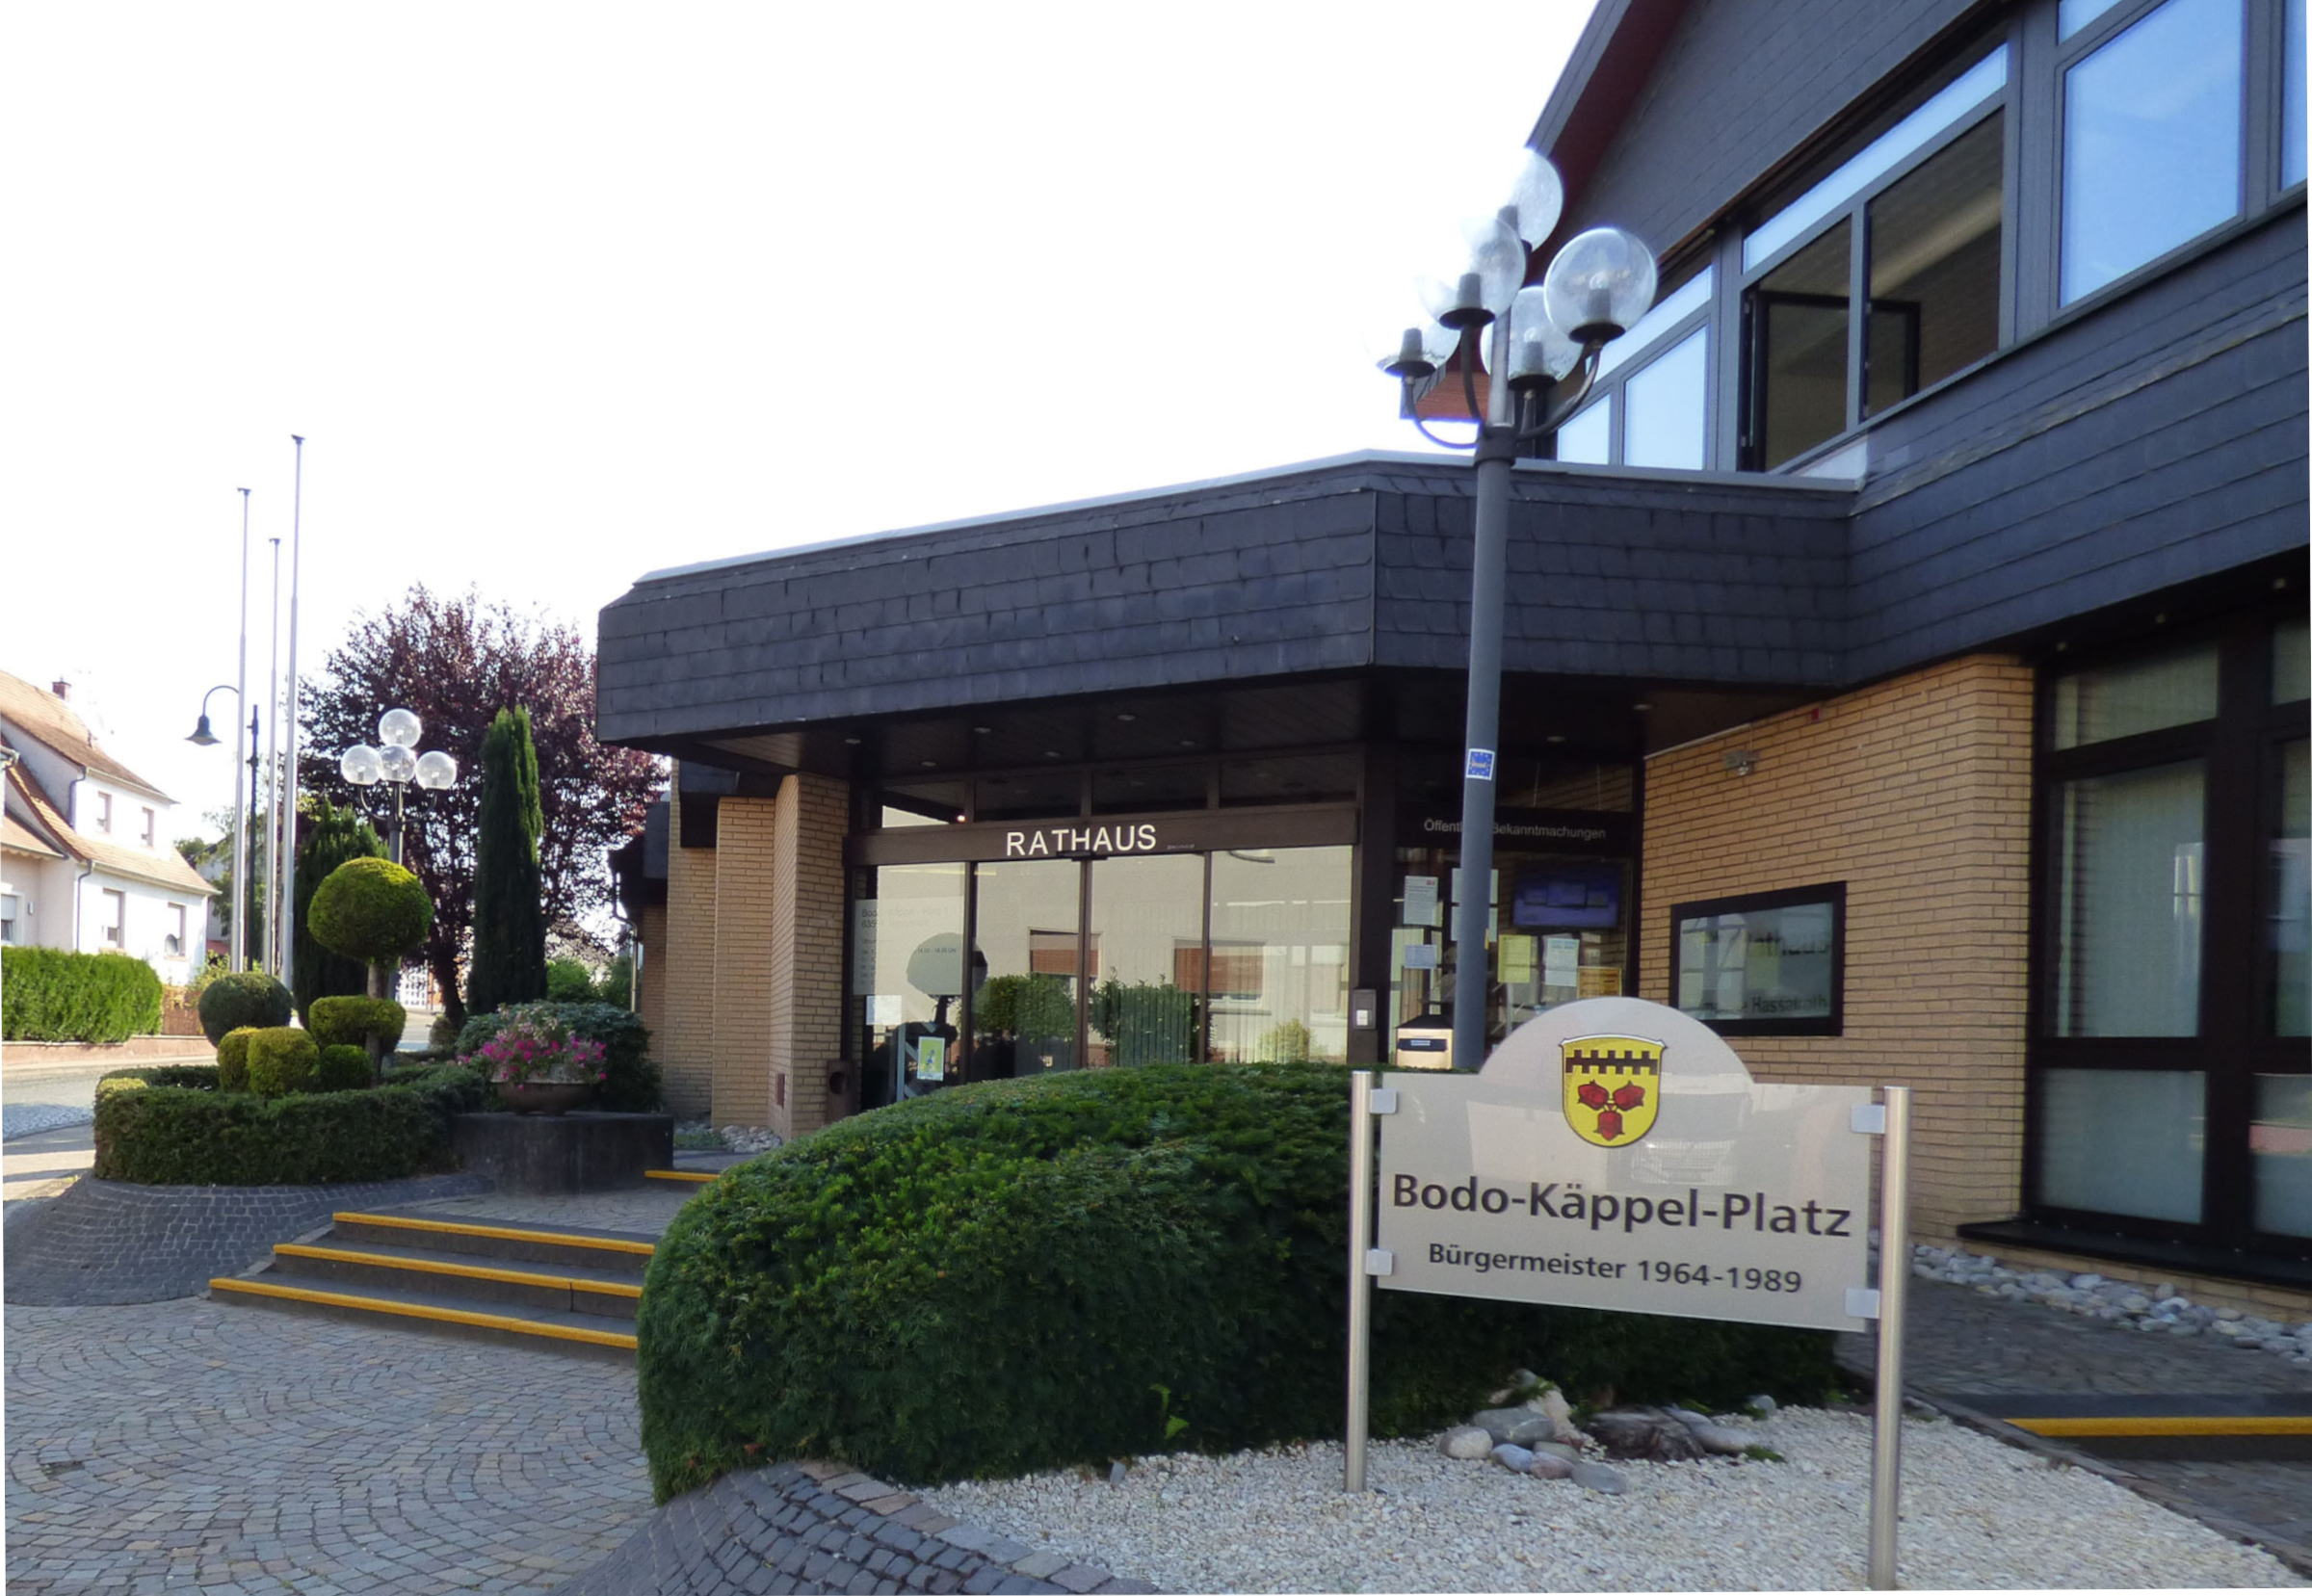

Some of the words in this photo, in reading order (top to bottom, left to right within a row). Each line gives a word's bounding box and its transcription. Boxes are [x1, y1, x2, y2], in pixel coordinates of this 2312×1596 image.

[1007, 824, 1156, 856] RATHAUS
[1491, 822, 1606, 841] Bekanntmachungen
[1393, 1173, 1852, 1238] Bodo-Käppel-Platz
[1429, 1243, 1627, 1279] Bürgermeister
[1638, 1260, 1801, 1294] 1964-1989
